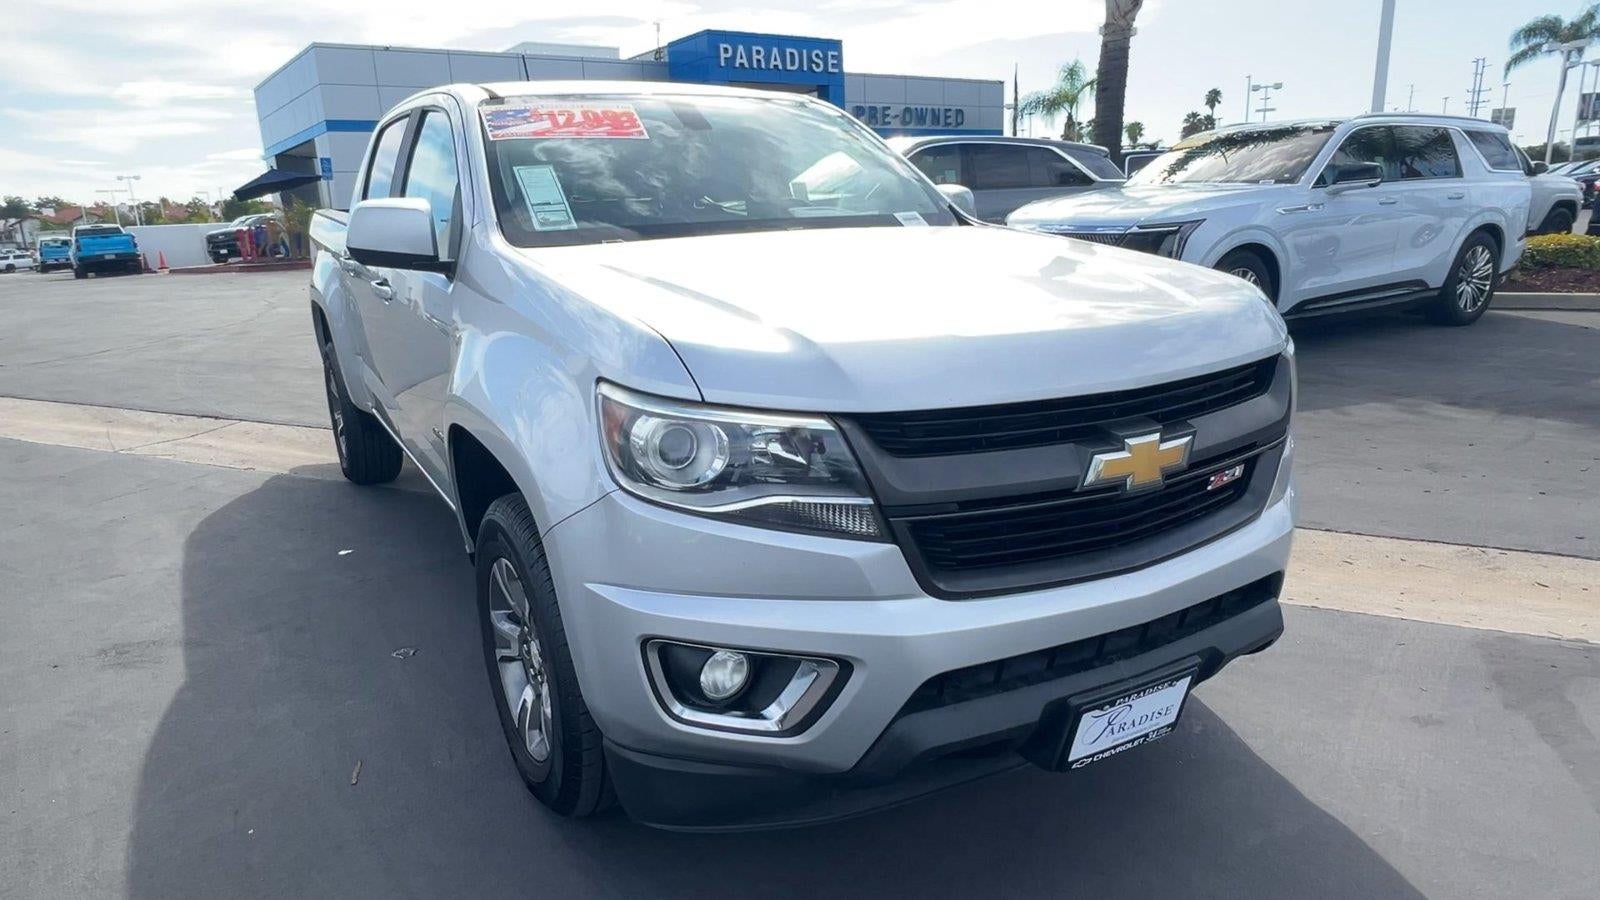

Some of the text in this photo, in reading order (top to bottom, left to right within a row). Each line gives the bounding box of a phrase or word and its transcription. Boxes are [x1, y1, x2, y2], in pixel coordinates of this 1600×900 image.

[719, 43, 841, 74] PARADISE
[853, 104, 965, 128] PRE-OWNED
[1115, 681, 1172, 706] PARADISE
[1093, 737, 1146, 761] CHEVROLET
